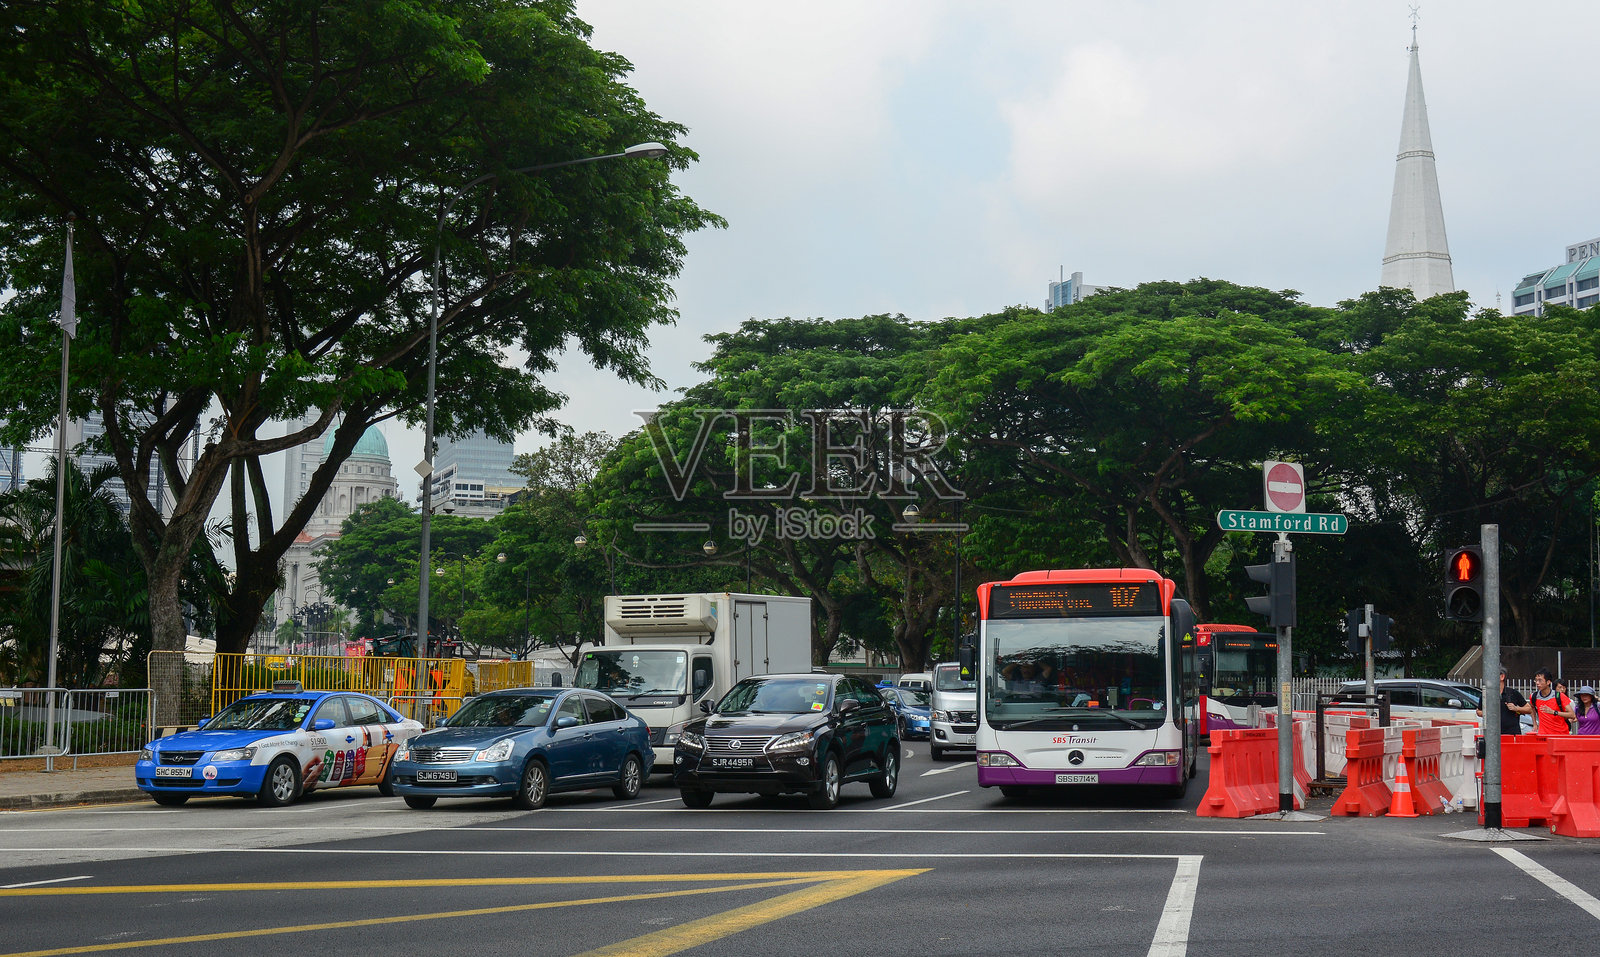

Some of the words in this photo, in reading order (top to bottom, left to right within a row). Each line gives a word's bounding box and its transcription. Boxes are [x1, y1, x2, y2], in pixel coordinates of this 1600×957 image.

[1228, 513, 1312, 531] Stamford
[1319, 516, 1339, 531] Rd
[1109, 586, 1140, 608] 107
[1052, 736, 1067, 744] SBS
[1066, 735, 1098, 744] Transit
[712, 758, 754, 767] SJR4495R
[418, 771, 456, 780] SJW6749U
